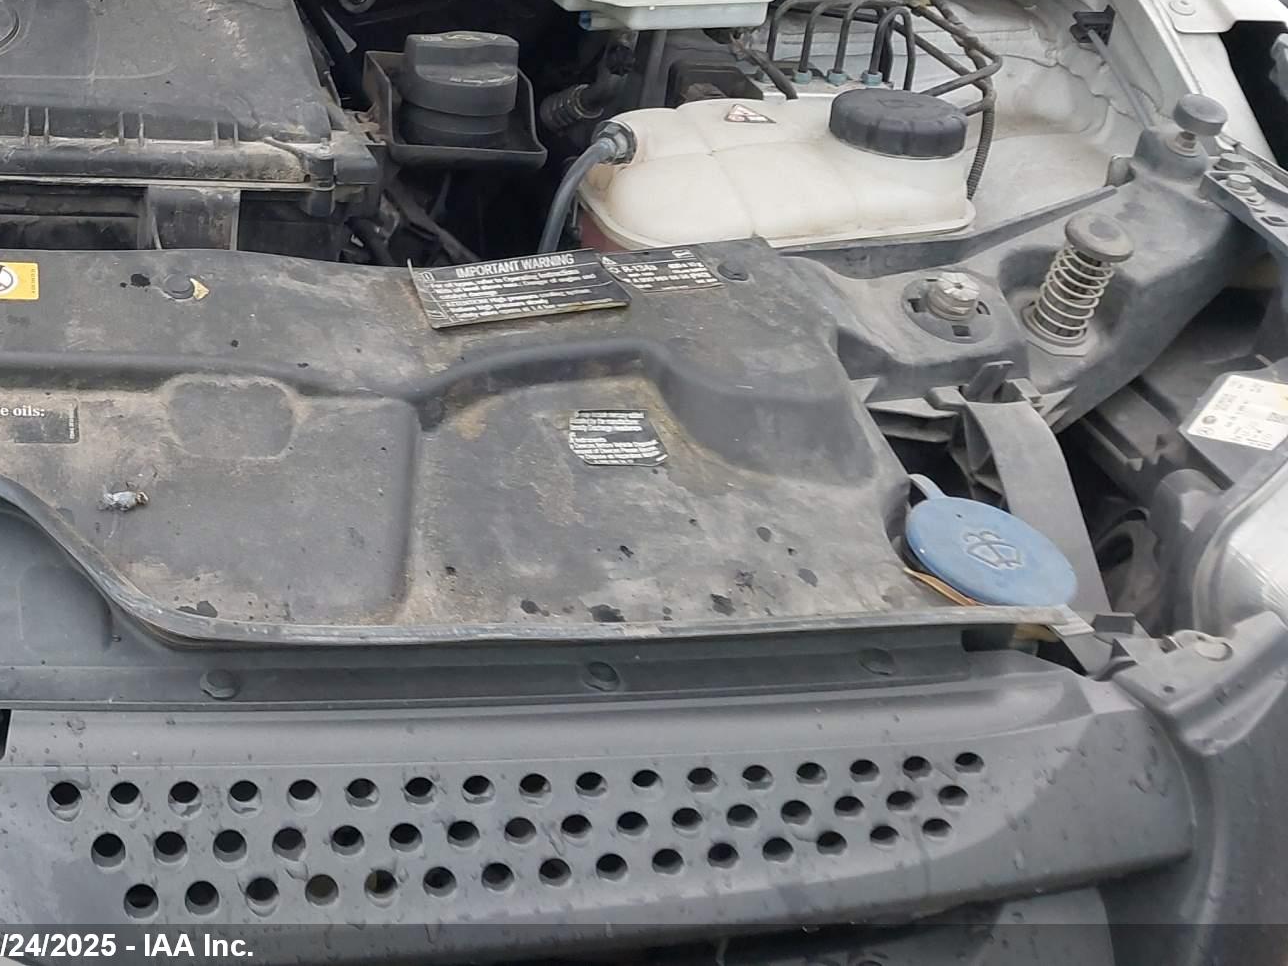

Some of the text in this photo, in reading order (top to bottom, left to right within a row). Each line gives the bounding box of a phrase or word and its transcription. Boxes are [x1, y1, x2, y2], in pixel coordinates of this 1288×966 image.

[456, 253, 575, 278] IMPORTANT WARNING
[13, 405, 45, 417] oils:
